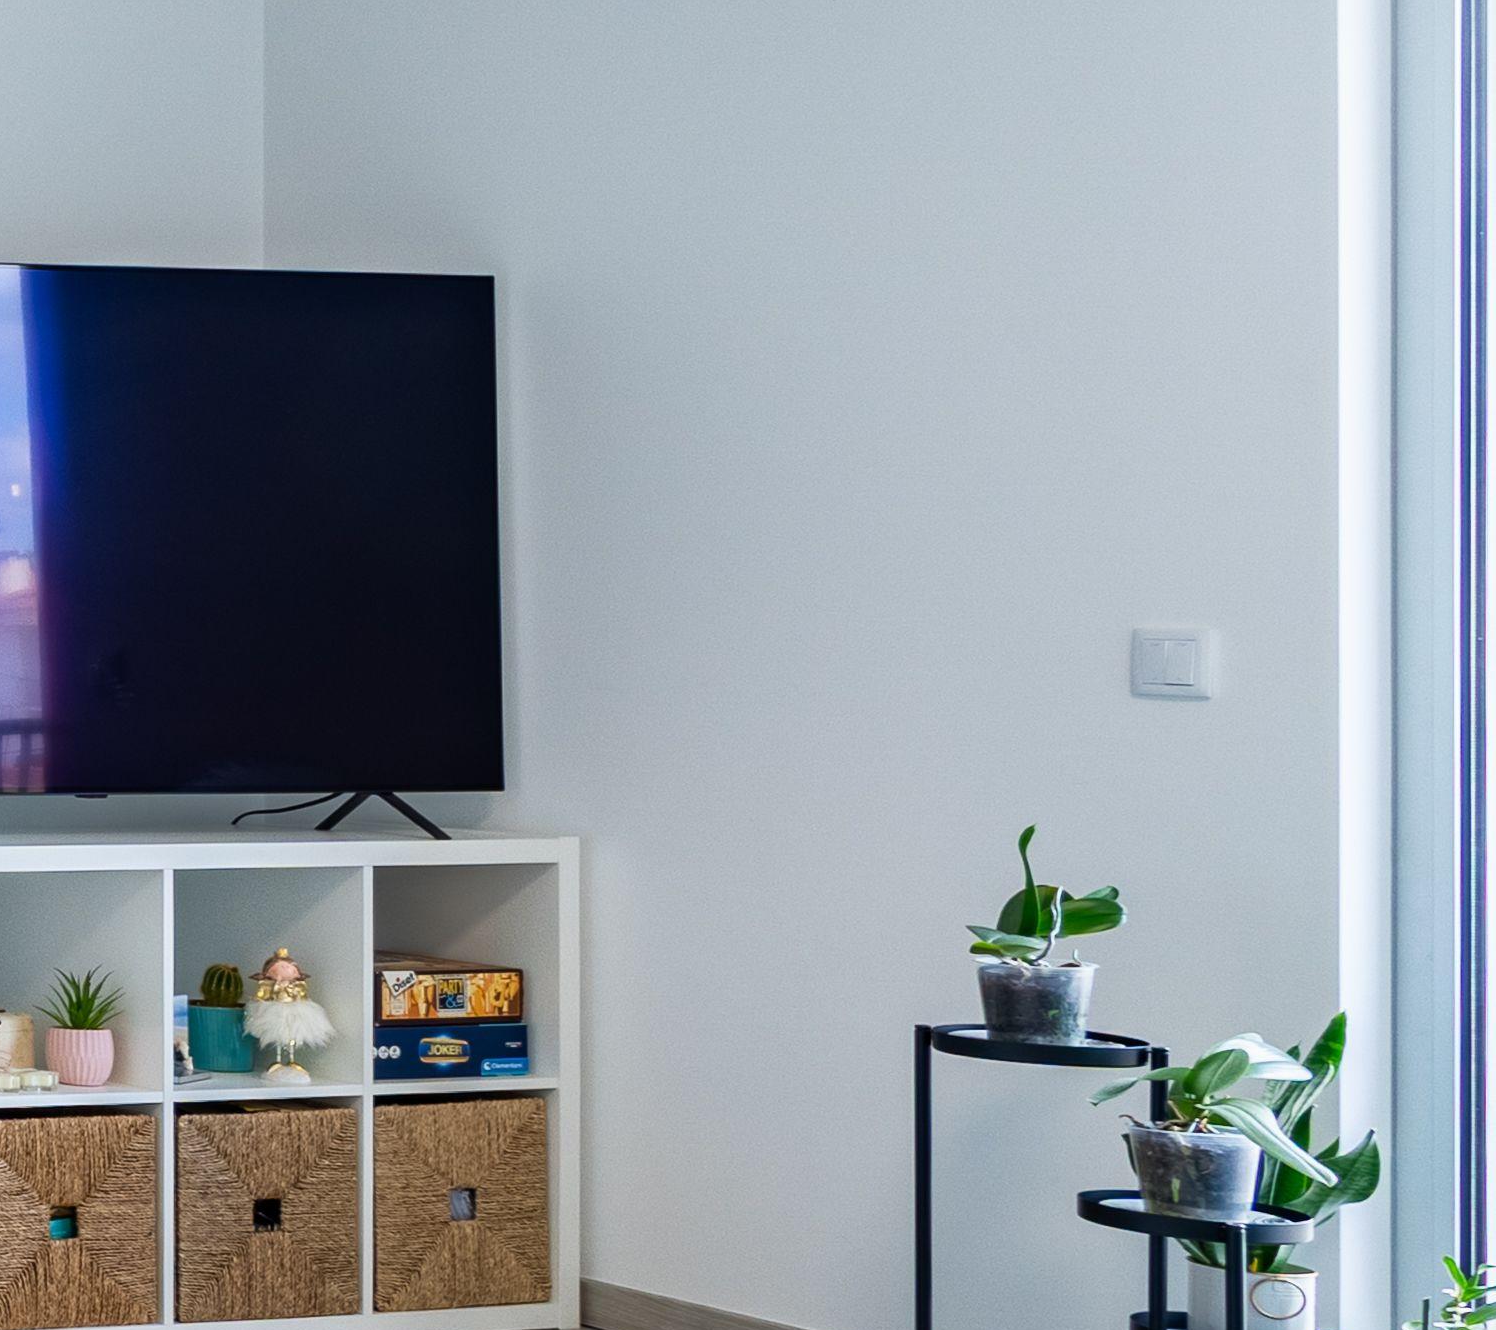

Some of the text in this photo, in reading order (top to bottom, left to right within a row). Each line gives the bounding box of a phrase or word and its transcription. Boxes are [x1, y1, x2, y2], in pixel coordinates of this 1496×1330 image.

[393, 974, 415, 992] Diset
[439, 980, 462, 993] PARTY
[428, 1045, 462, 1055] JOKER
